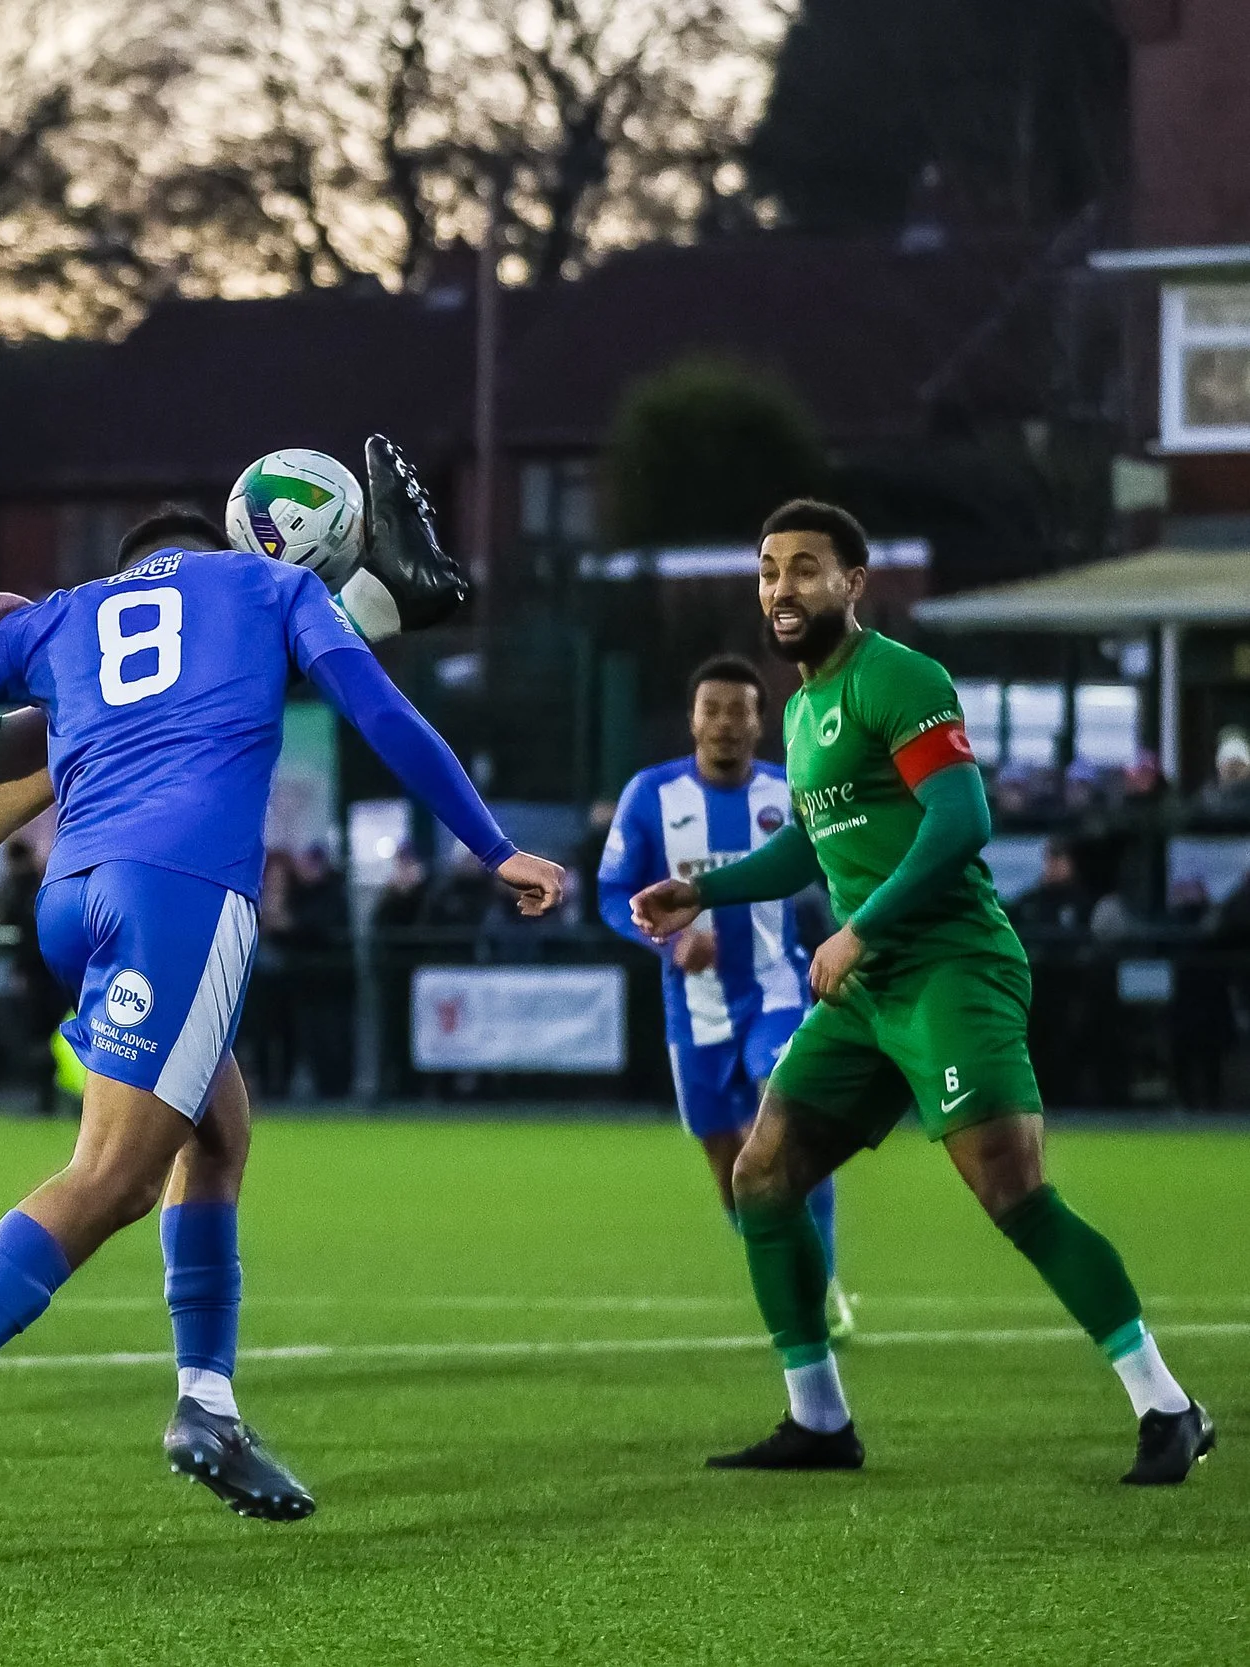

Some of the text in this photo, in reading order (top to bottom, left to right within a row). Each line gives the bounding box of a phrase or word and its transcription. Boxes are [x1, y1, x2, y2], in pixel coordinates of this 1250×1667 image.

[105, 560, 180, 584] TOUCH
[97, 586, 184, 707] 8
[804, 782, 855, 828] pure
[110, 984, 146, 1013] DP's
[96, 1036, 138, 1061] SERVICES
[121, 1032, 159, 1054] ADVICE
[944, 1065, 960, 1094] 6
